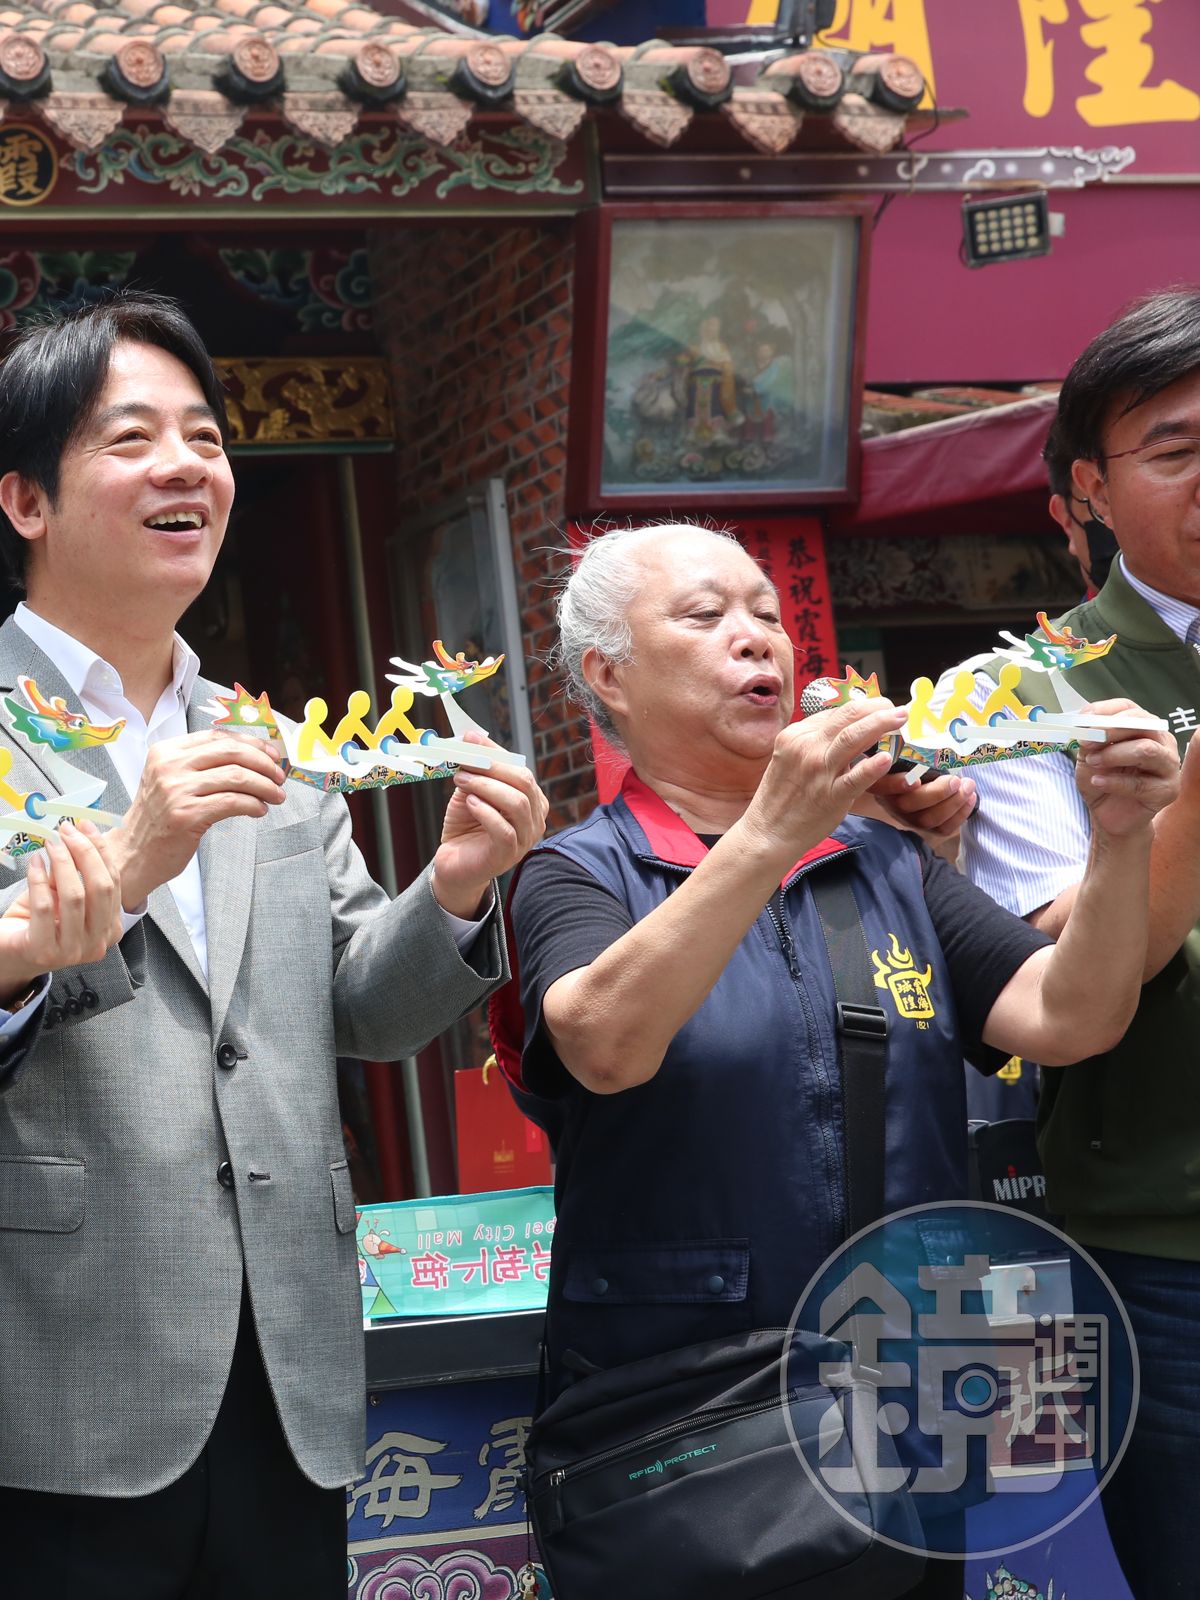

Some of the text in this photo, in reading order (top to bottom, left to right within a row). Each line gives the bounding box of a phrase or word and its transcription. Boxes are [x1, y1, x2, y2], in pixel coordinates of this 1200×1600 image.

[417, 1230, 463, 1250] Mall
[473, 1223, 515, 1242] City
[628, 1443, 718, 1481] RFID PROTECT
